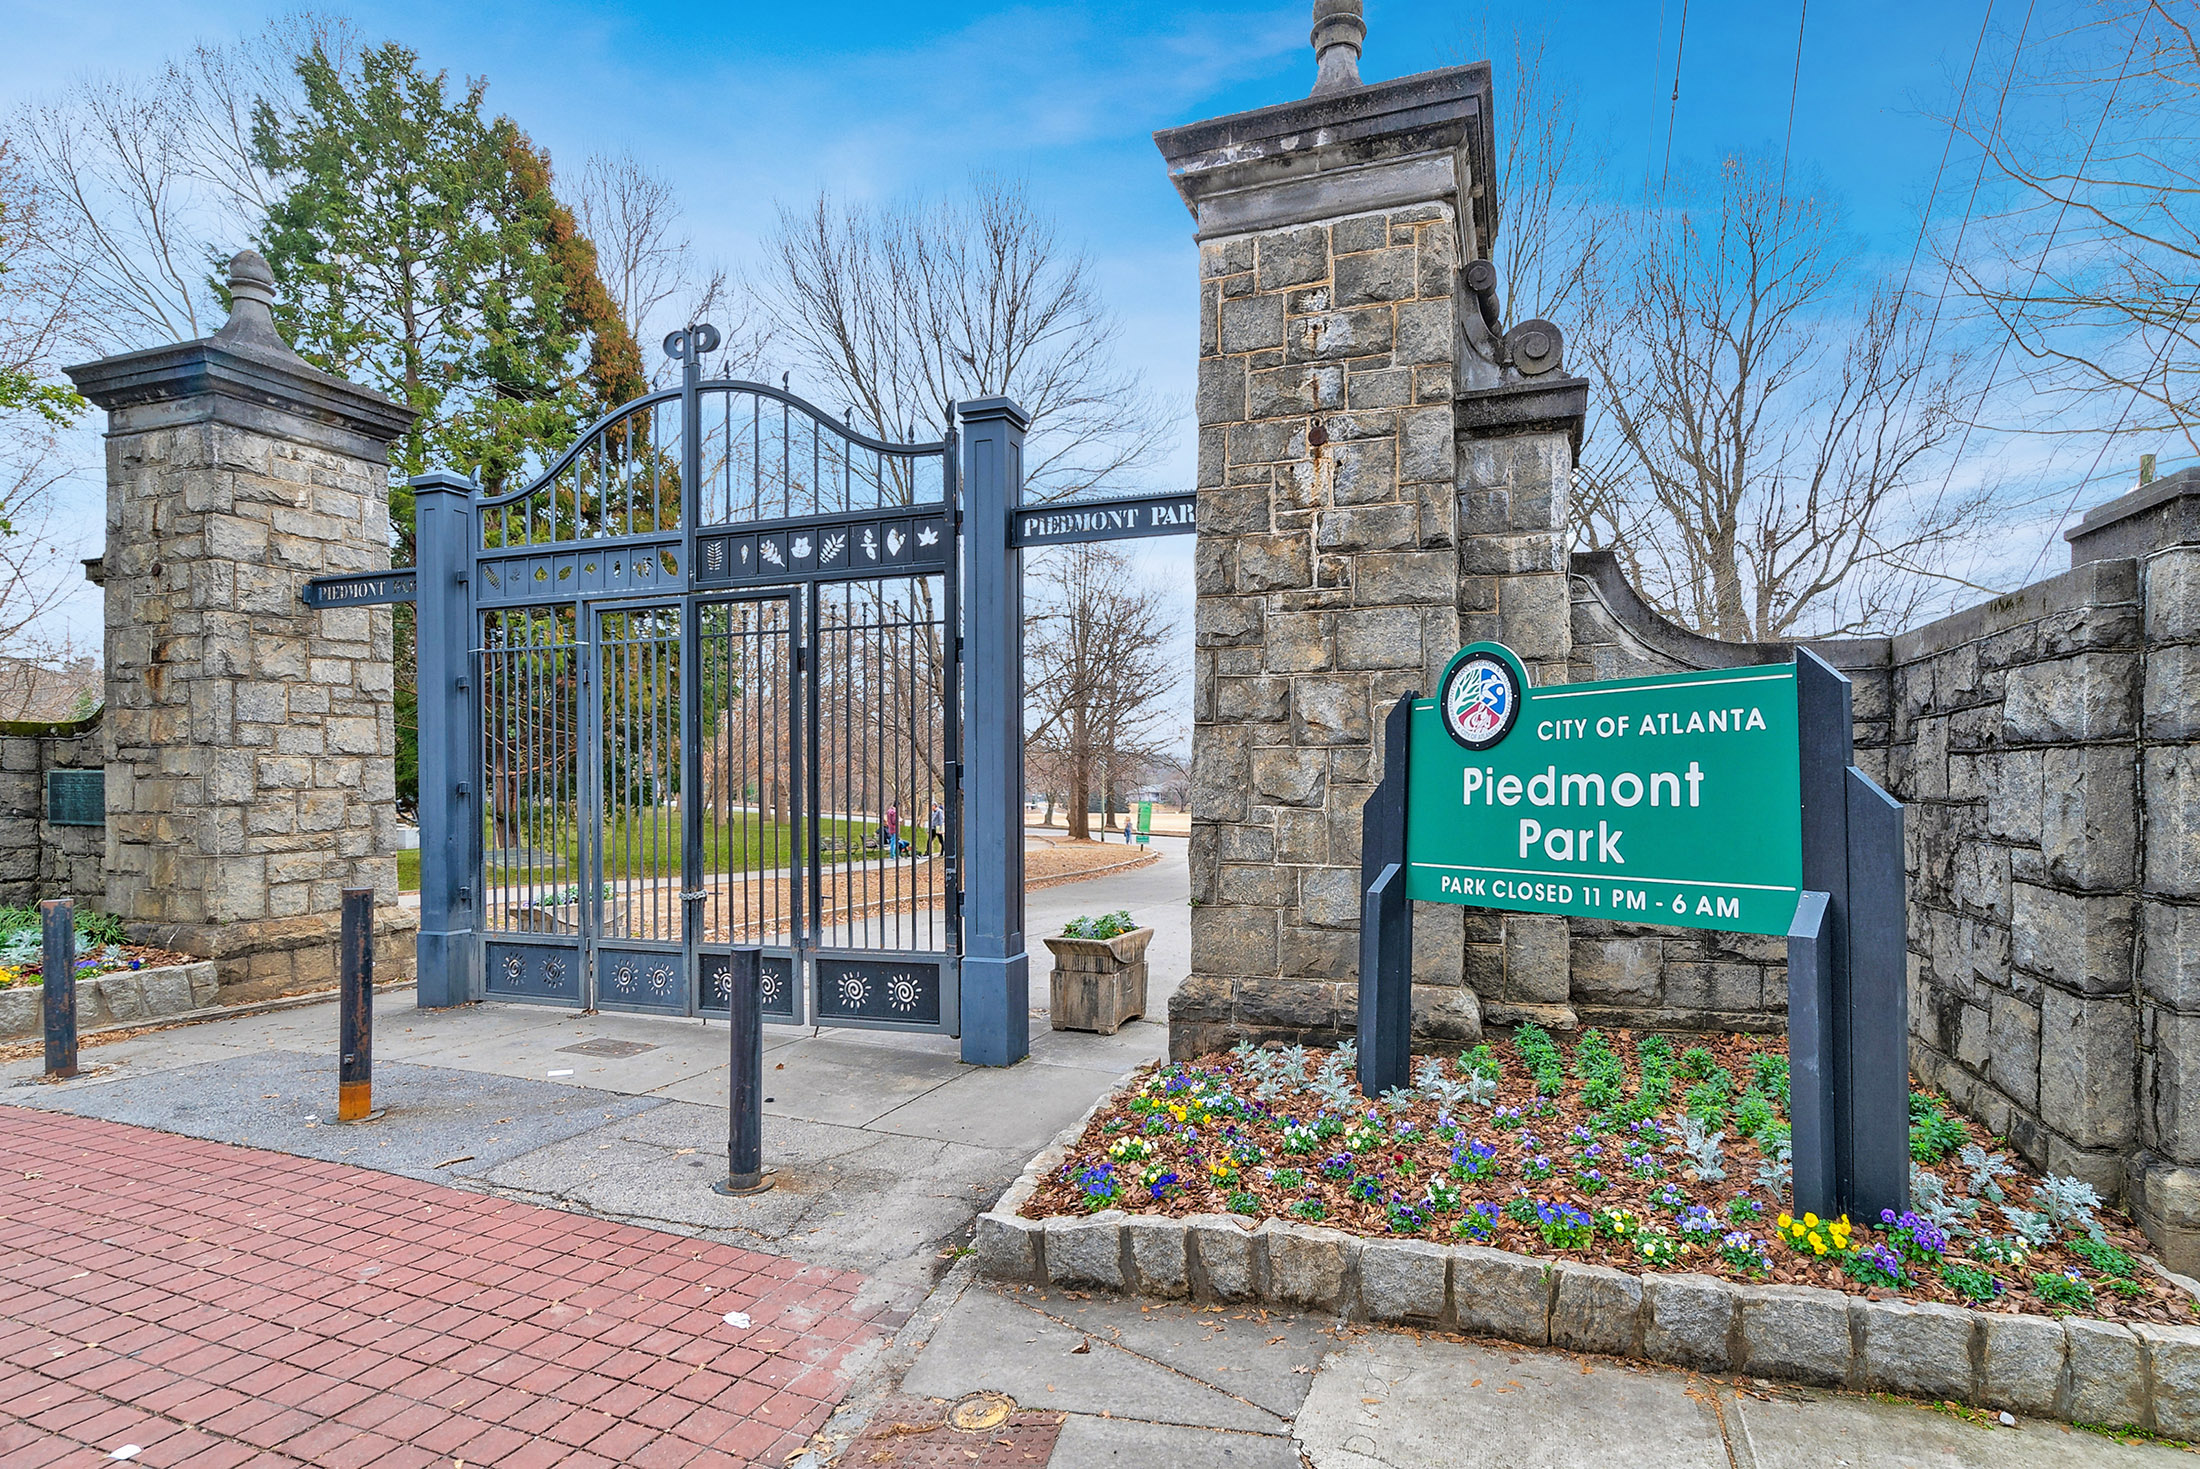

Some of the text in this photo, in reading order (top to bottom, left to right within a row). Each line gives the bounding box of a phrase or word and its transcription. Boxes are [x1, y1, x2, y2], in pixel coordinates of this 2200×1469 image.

[1023, 508, 1139, 537] PIEDMONT
[318, 581, 386, 601] PIEDMONT
[1537, 707, 1767, 741] CITY OF ATLANTA
[1463, 761, 1705, 807] Piedmont
[1519, 818, 1625, 864] Park
[1441, 875, 1486, 896] PARK
[1492, 879, 1573, 904] CLOSED
[1582, 886, 1600, 907] 11
[1612, 888, 1646, 911] PM
[1672, 893, 1687, 914] 6
[1695, 895, 1739, 919] AM
